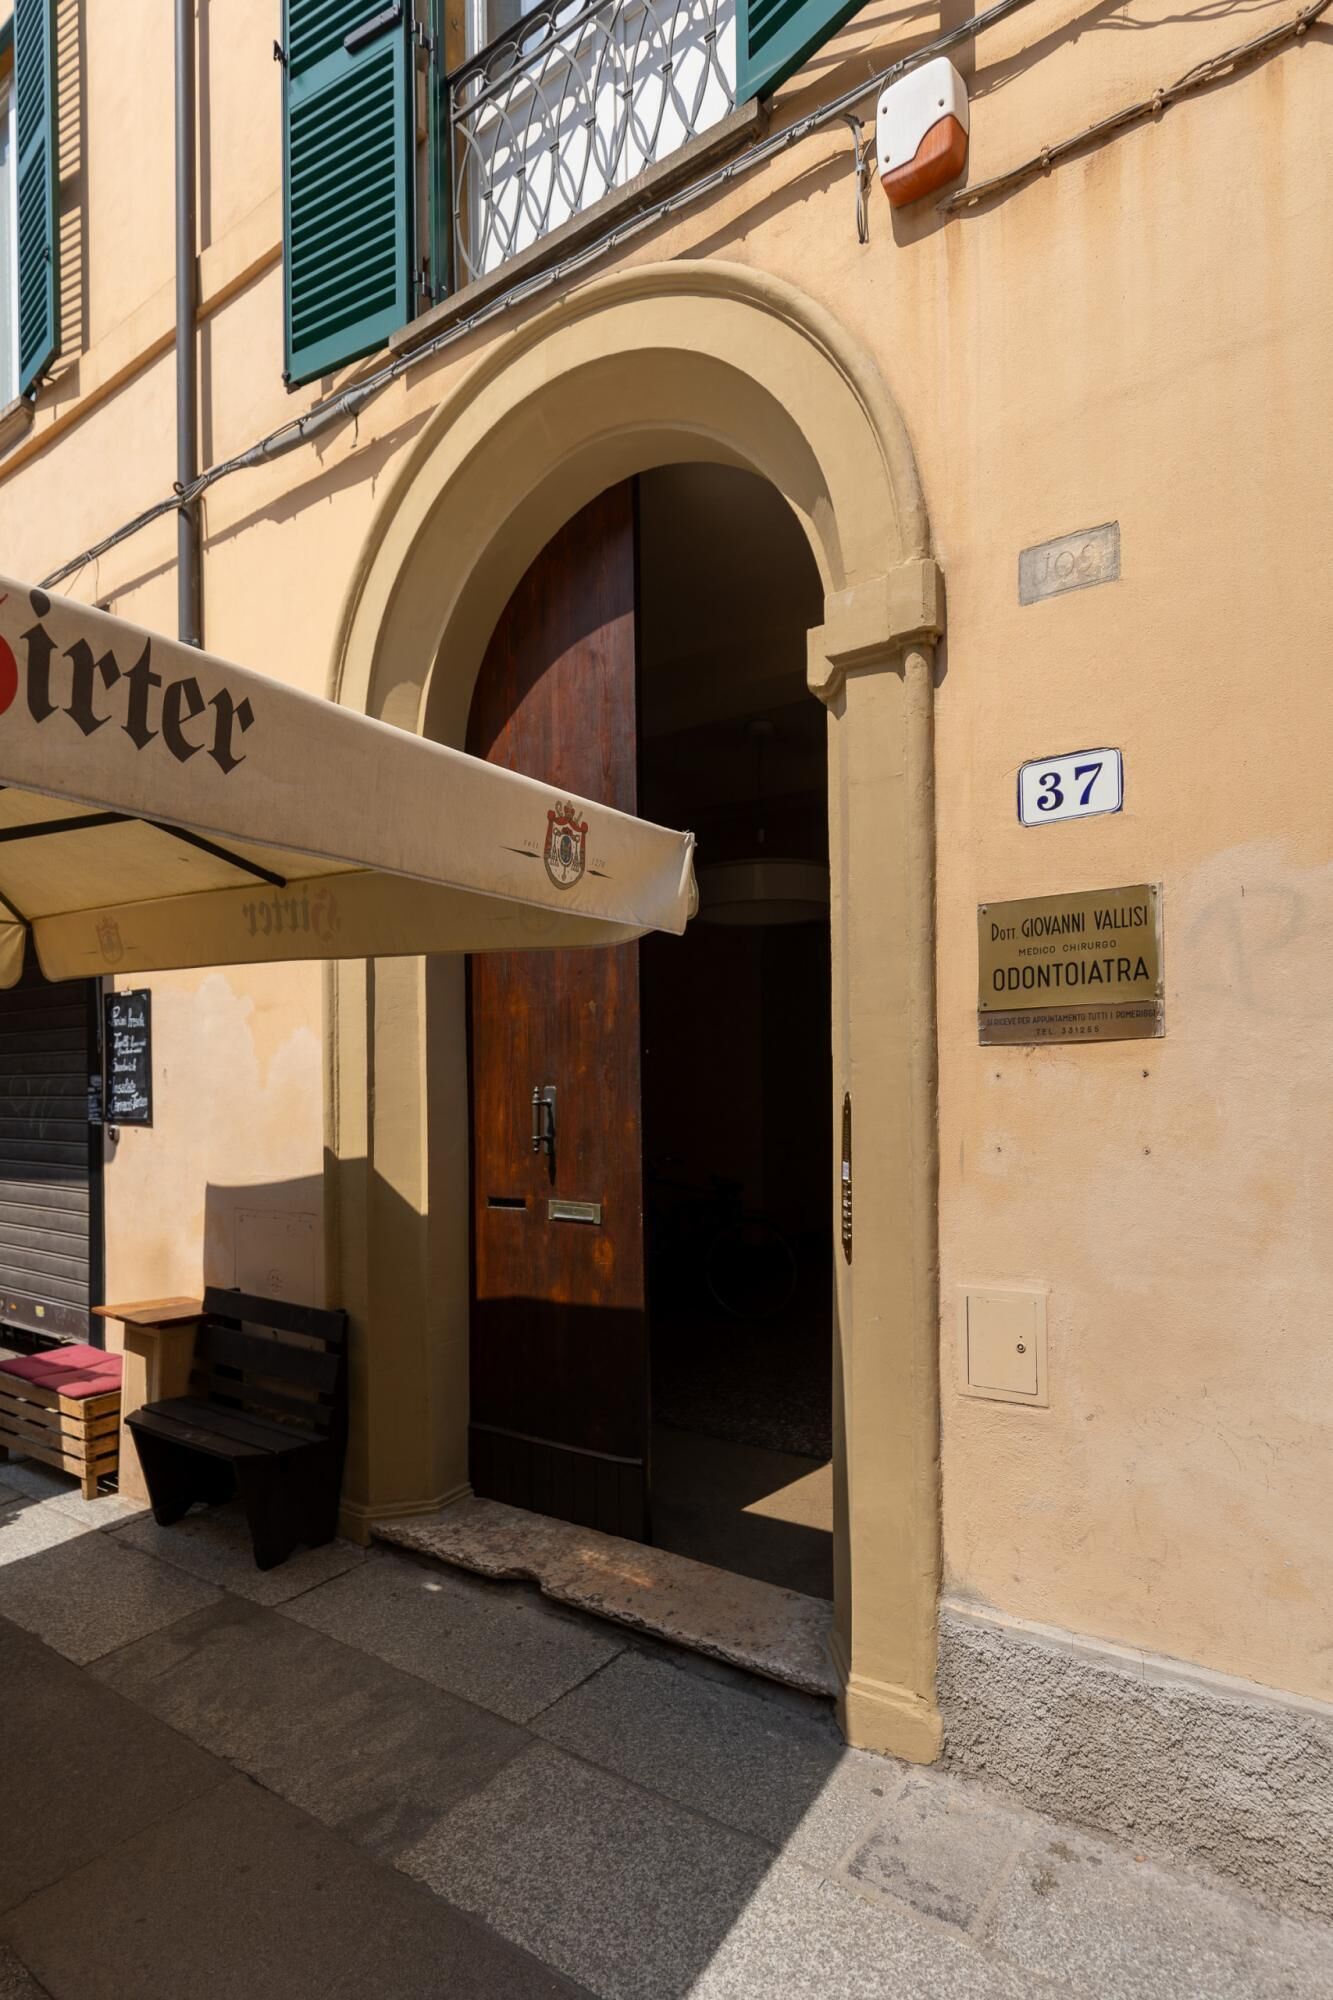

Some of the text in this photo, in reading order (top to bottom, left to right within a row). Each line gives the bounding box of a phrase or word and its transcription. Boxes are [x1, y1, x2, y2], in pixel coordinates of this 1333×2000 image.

[0, 588, 256, 776] irter
[1036, 762, 1103, 812] 37
[1021, 912, 1085, 938] GIOVANNI
[1094, 905, 1148, 931] VALLISI
[1018, 939, 1117, 957] MEDICO CHIRURGO
[992, 956, 1150, 992] ODONTOIATRA
[1032, 1013, 1086, 1025] APPUNTAMENTO
[1088, 1011, 1108, 1021] TUTTI
